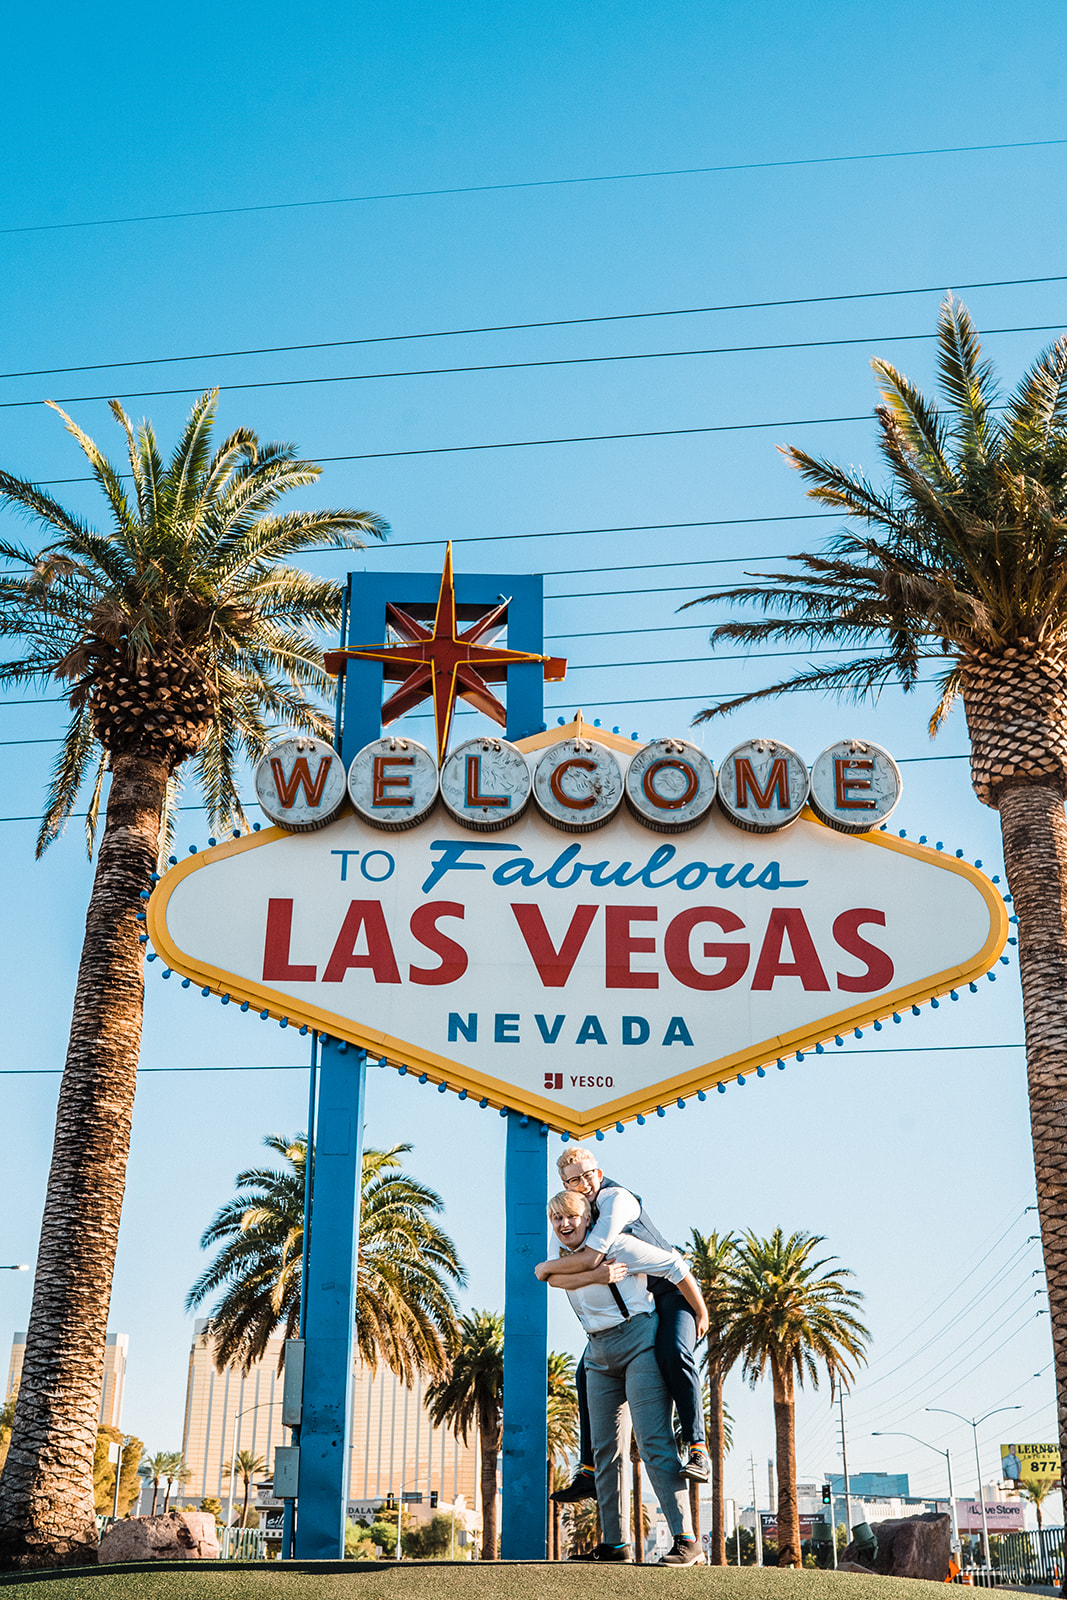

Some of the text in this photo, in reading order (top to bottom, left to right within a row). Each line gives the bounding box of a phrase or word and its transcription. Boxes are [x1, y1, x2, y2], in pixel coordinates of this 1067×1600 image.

[268, 755, 879, 811] WELCOME
[331, 839, 809, 894] TO Fabulous
[262, 898, 895, 993] LAS VEGAS
[447, 1012, 694, 1047] NEVADA
[570, 1075, 614, 1088] YESCO
[996, 1505, 1020, 1514] Store
